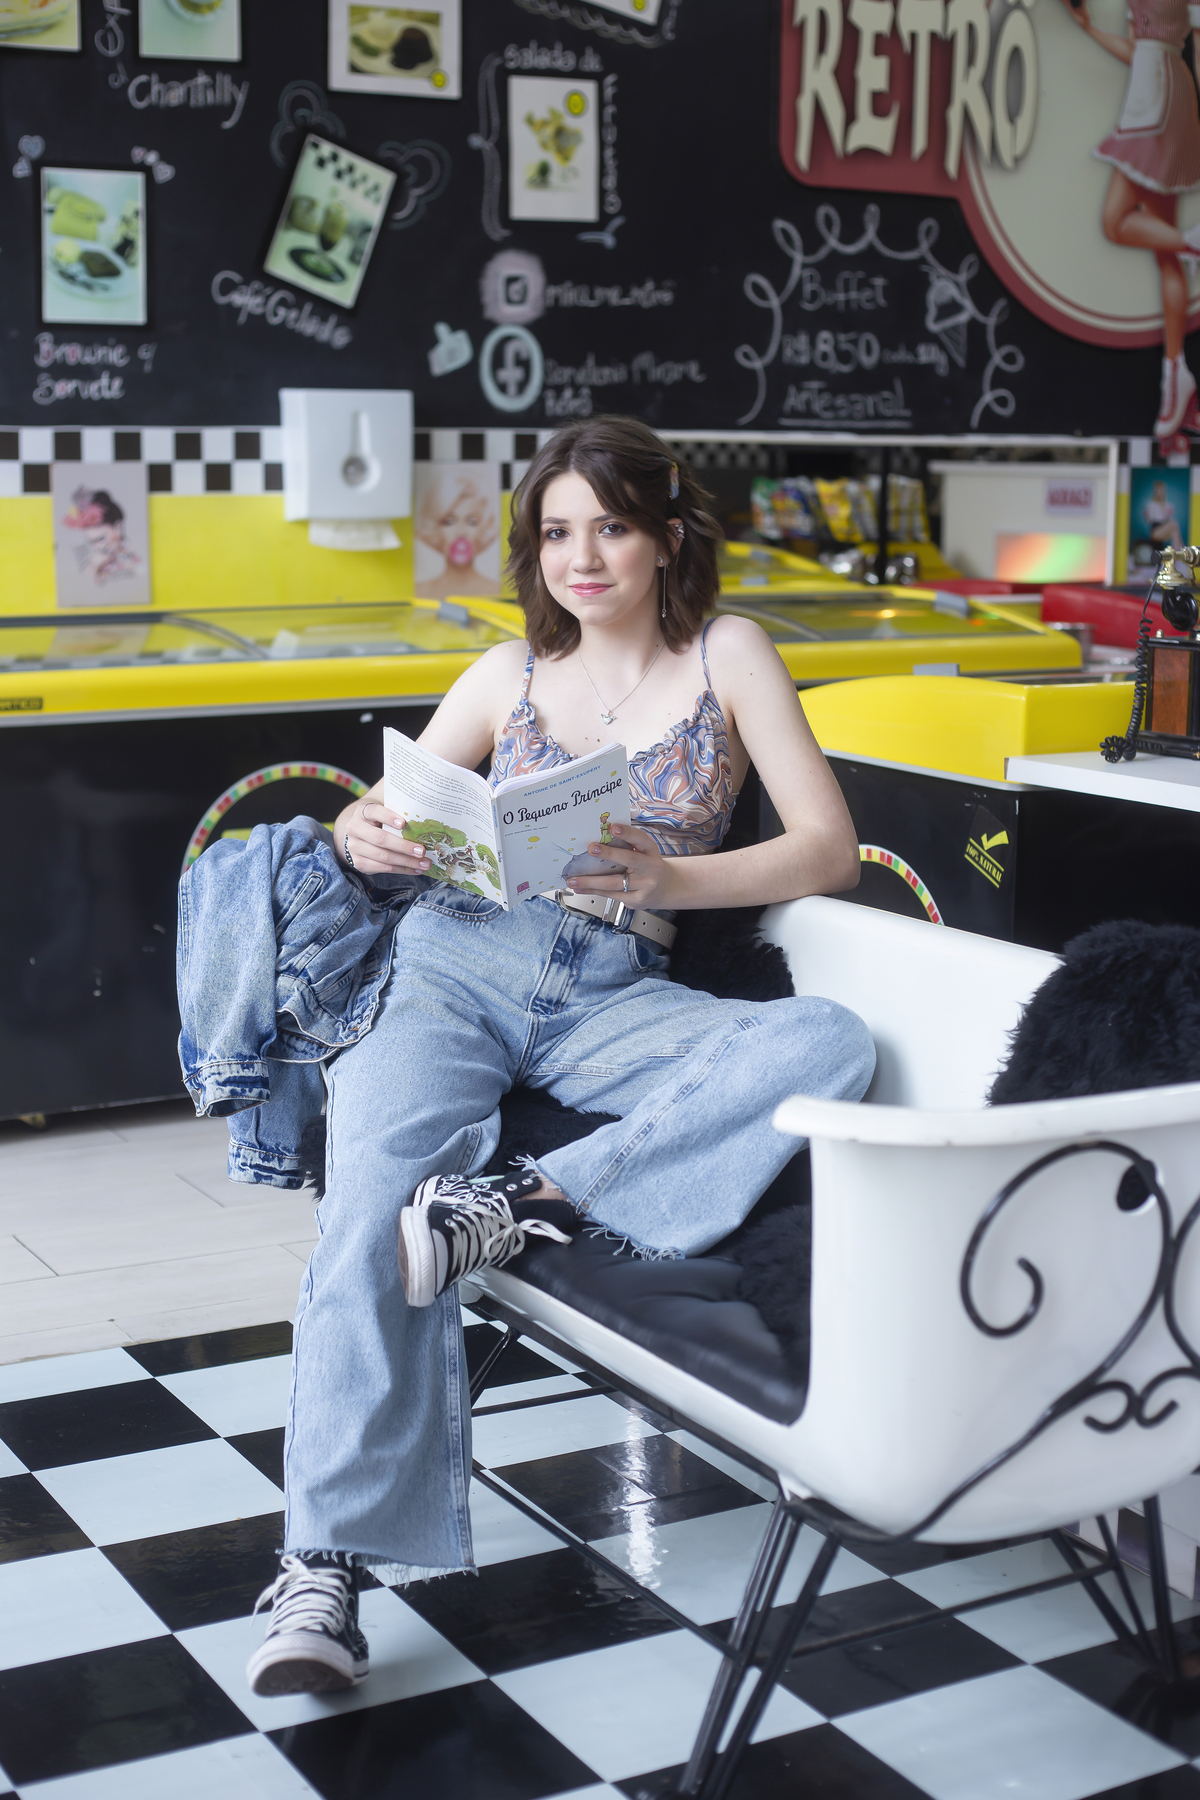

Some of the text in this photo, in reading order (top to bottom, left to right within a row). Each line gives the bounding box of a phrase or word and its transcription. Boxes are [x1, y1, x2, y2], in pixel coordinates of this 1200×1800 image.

[127, 69, 249, 129] Chantilly
[799, 266, 888, 312] Buffet
[34, 332, 130, 368] Brownie
[32, 370, 126, 406] Sorvete
[784, 377, 911, 418] Artesanal
[503, 811, 515, 825] O
[517, 801, 569, 824] Pequeno
[571, 778, 623, 808] Príncipe
[523, 784, 549, 797] ANTOINE
[549, 782, 558, 791] DE
[966, 843, 1002, 882] 100% NATURAL
